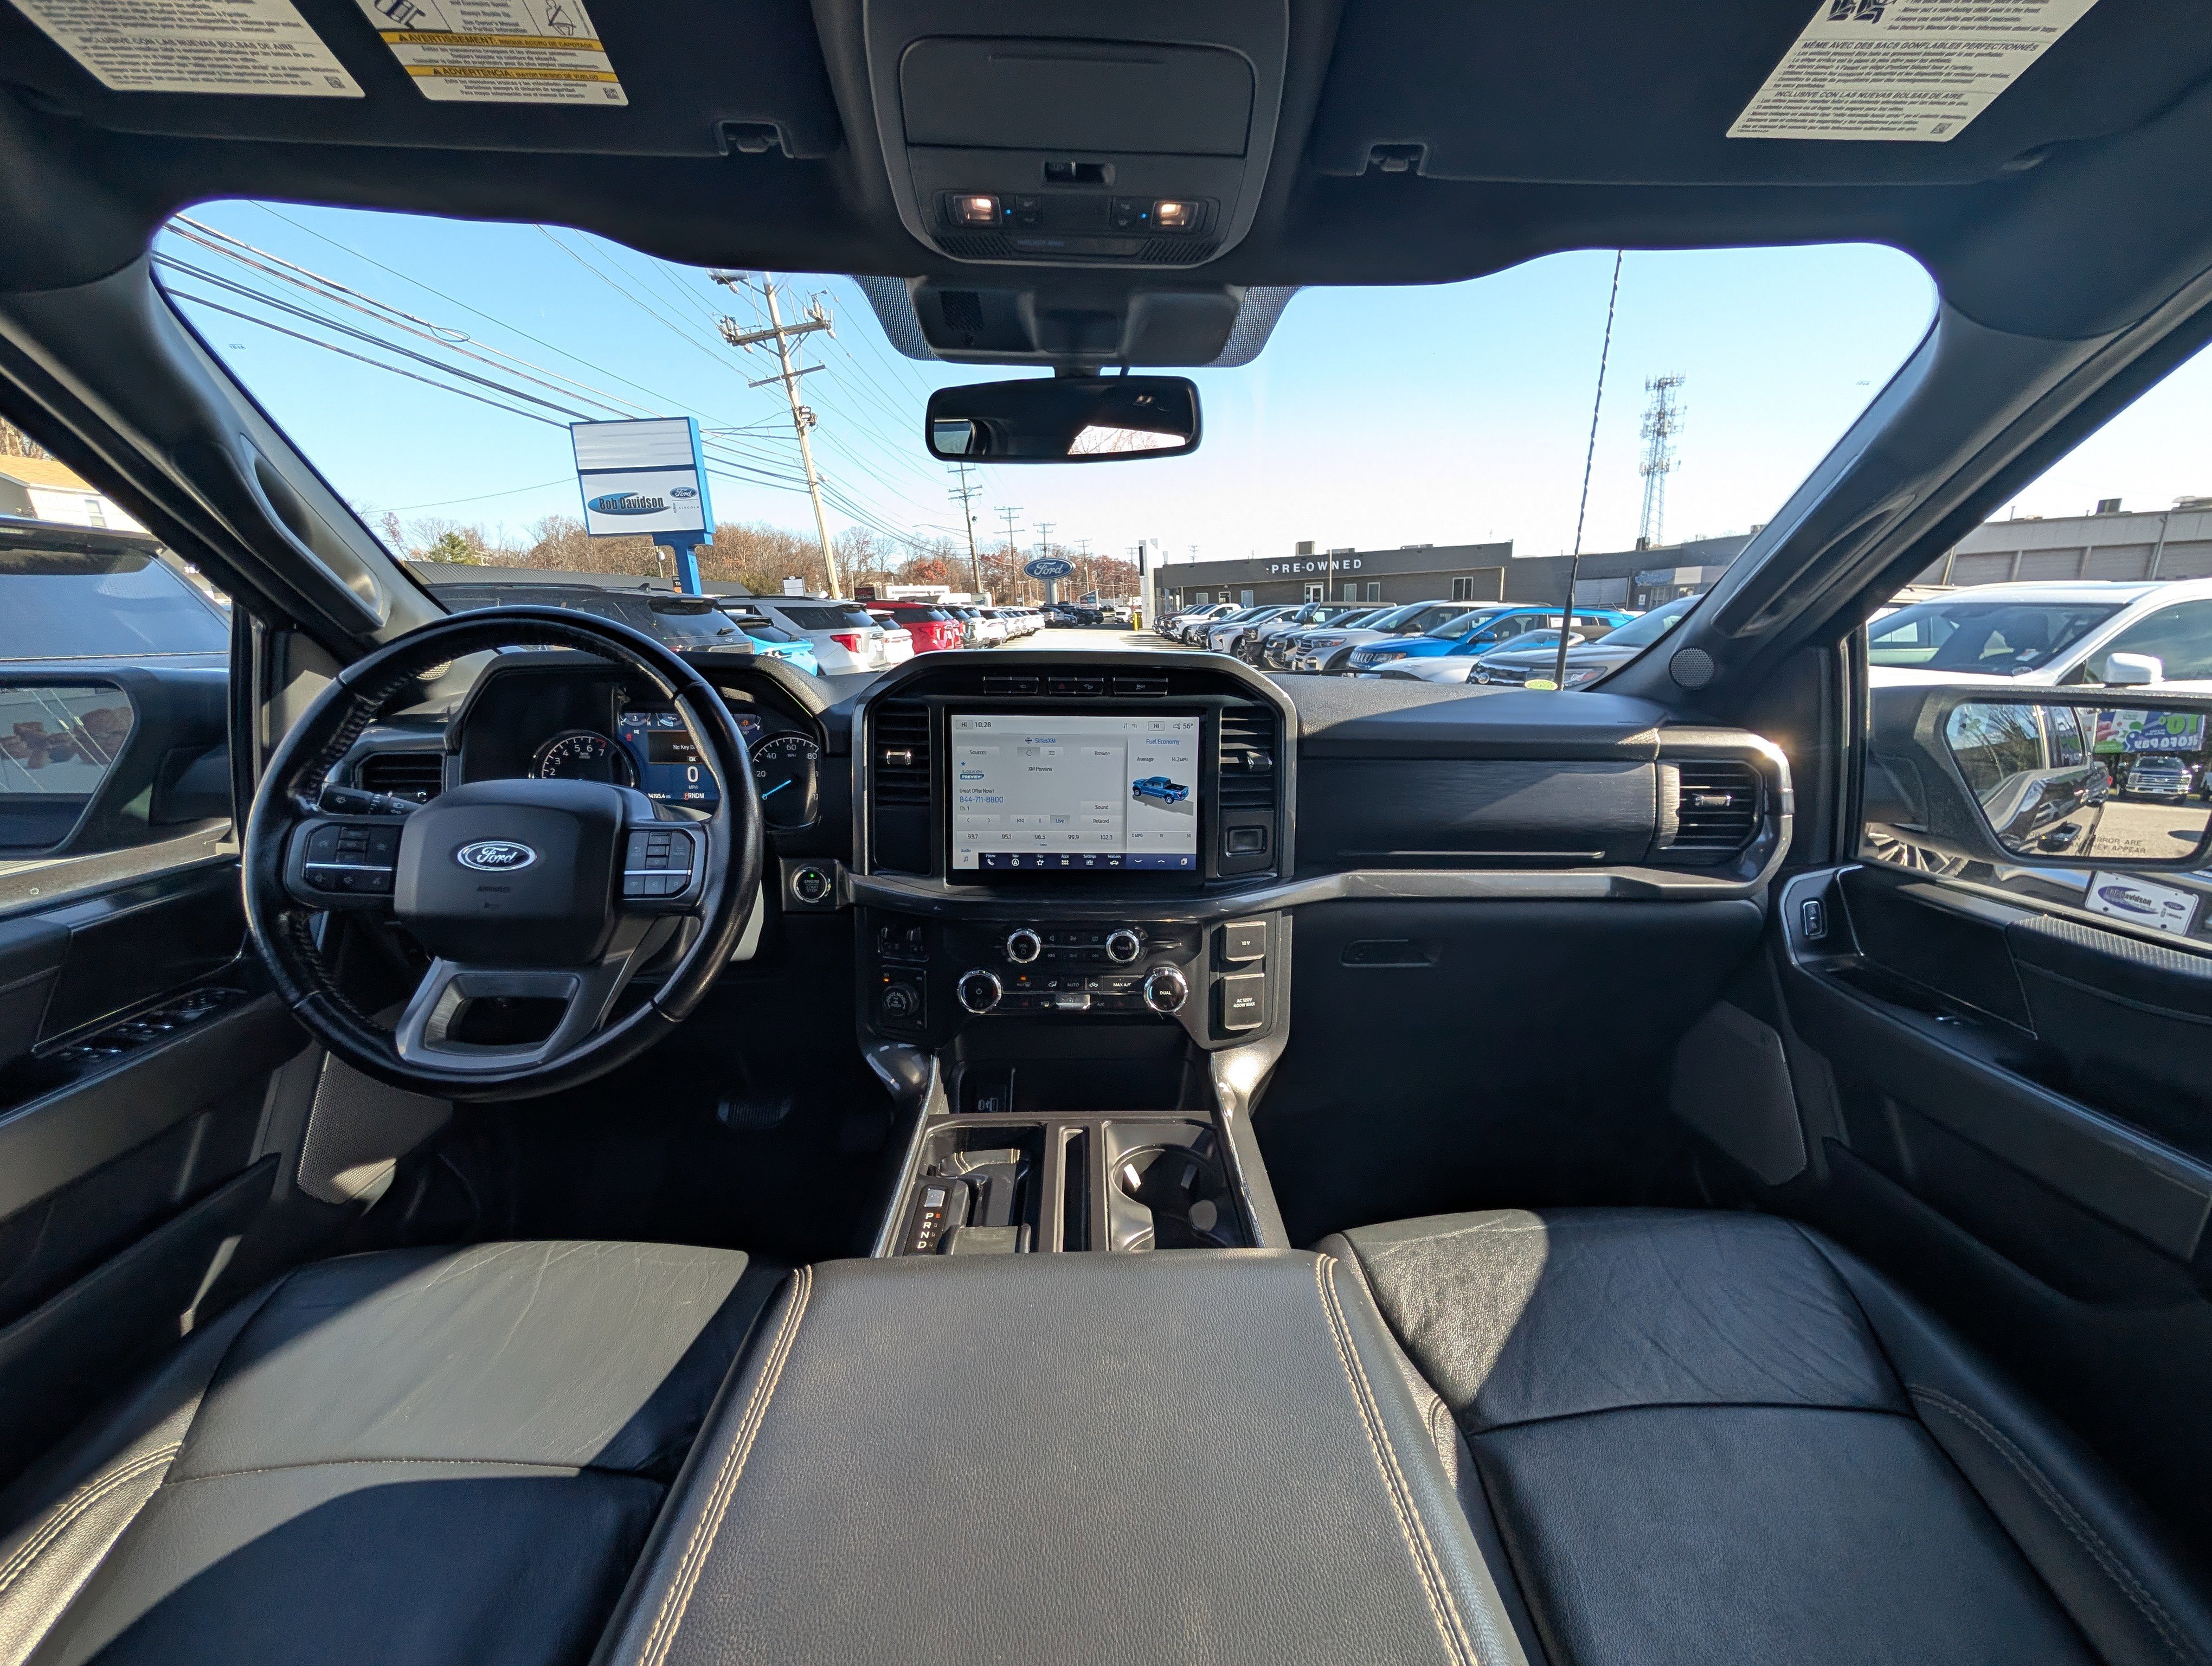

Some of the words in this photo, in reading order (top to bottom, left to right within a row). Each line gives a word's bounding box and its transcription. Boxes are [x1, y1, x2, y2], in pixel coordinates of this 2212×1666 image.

[599, 497, 618, 510] Bob
[619, 496, 664, 509] Davidson
[1271, 559, 1362, 574] PRE-OWNED
[687, 766, 699, 783] 0
[960, 796, 1004, 804] 844-711-8800
[2111, 845, 2146, 853] APPEAR
[2119, 891, 2152, 906] Davidson
[917, 1241, 927, 1249] D
